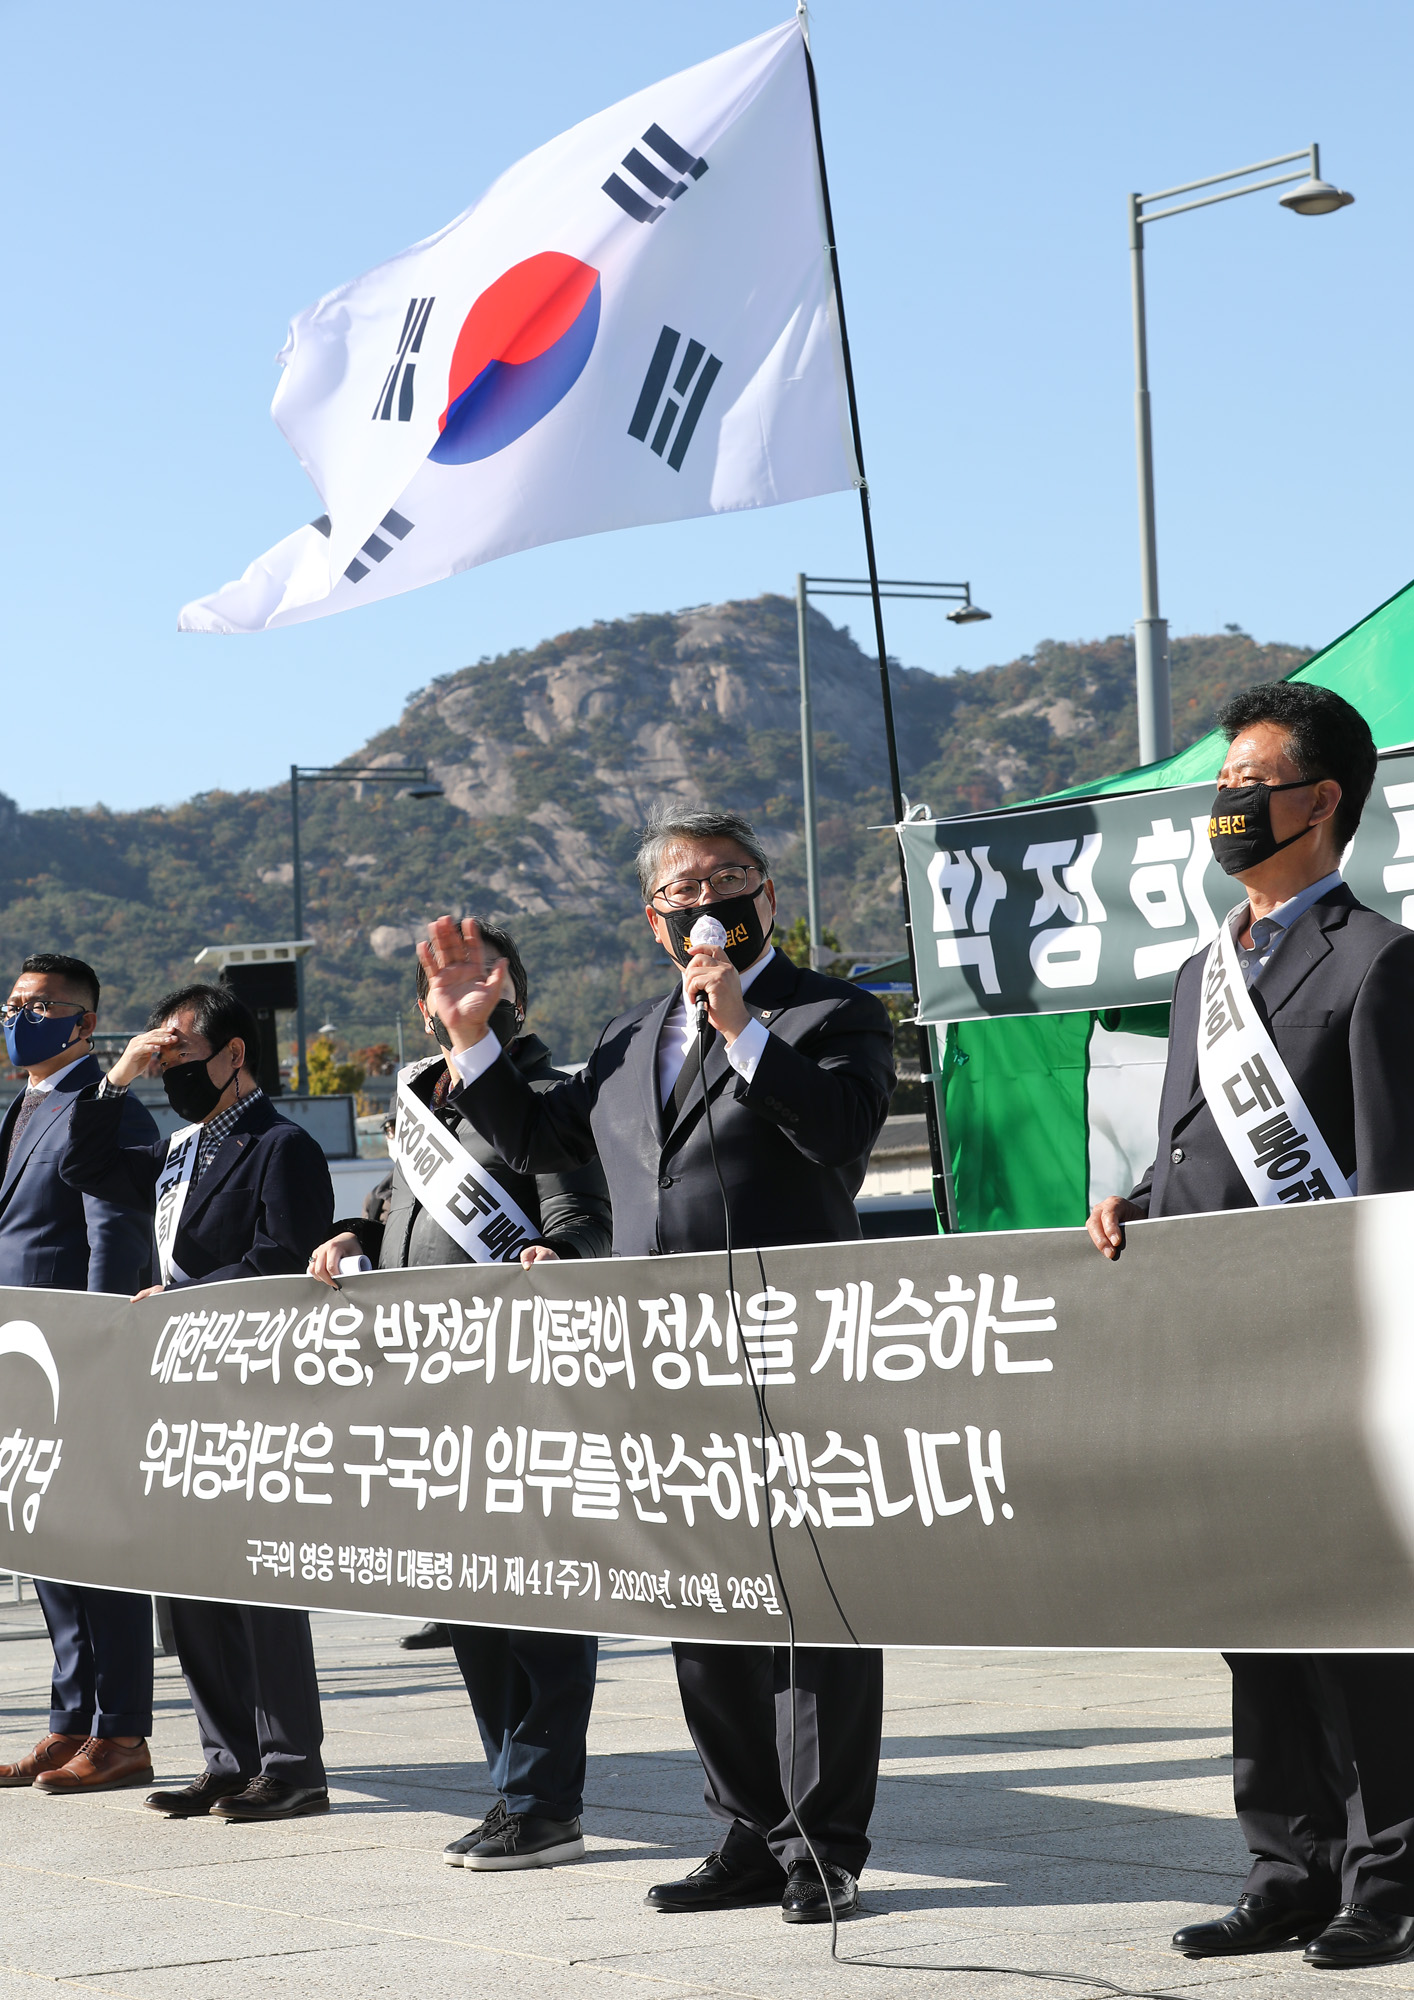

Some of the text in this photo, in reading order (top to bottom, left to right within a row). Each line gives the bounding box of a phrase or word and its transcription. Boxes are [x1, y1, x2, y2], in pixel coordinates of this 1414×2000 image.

[1218, 814, 1246, 835] 퇴진
[725, 923, 748, 948] 퇴진
[927, 815, 1222, 995] 박정희
[1203, 935, 1245, 1051] 정희
[397, 1096, 454, 1187] 정희
[150, 1273, 1058, 1391] 대한민국의 영웅, 박정희 대통령의 정신을 계승하는
[139, 1418, 1014, 1529] 우리공화당은 구국의 임무를 완수하겠습니다!
[246, 1539, 783, 1615] 구국의 영웅 박정희 대통령 서거 제41주기 2020년 10월 26일
